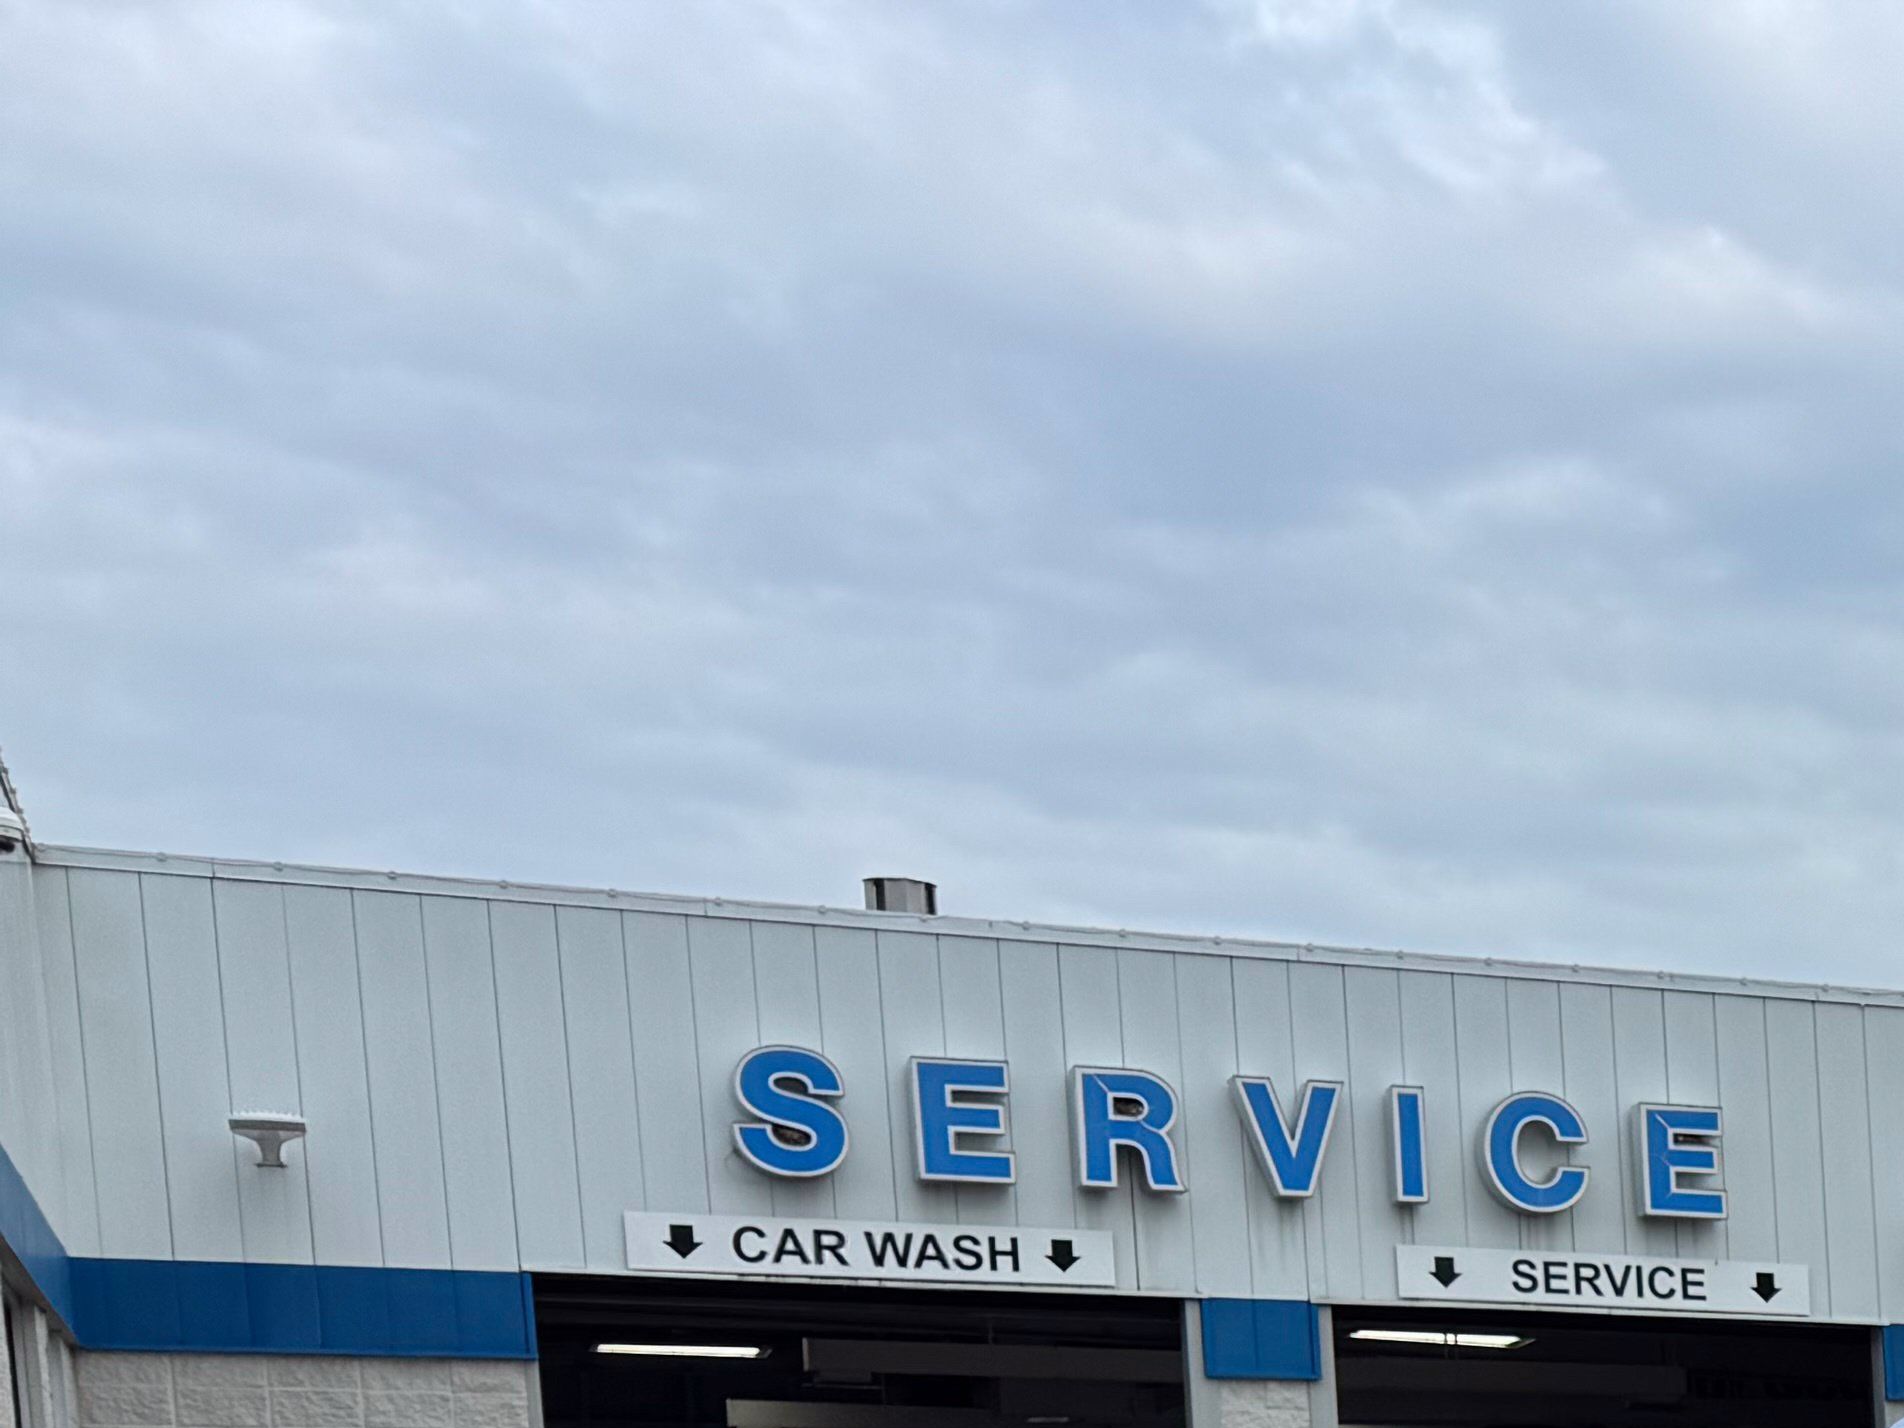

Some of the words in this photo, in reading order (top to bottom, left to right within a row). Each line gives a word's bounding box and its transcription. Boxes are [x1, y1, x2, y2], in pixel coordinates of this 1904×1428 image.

[731, 1043, 1730, 1221] SERVICE
[731, 1225, 849, 1267] CAR
[864, 1231, 1021, 1272] WASH
[1511, 1259, 1708, 1301] SERVICE
